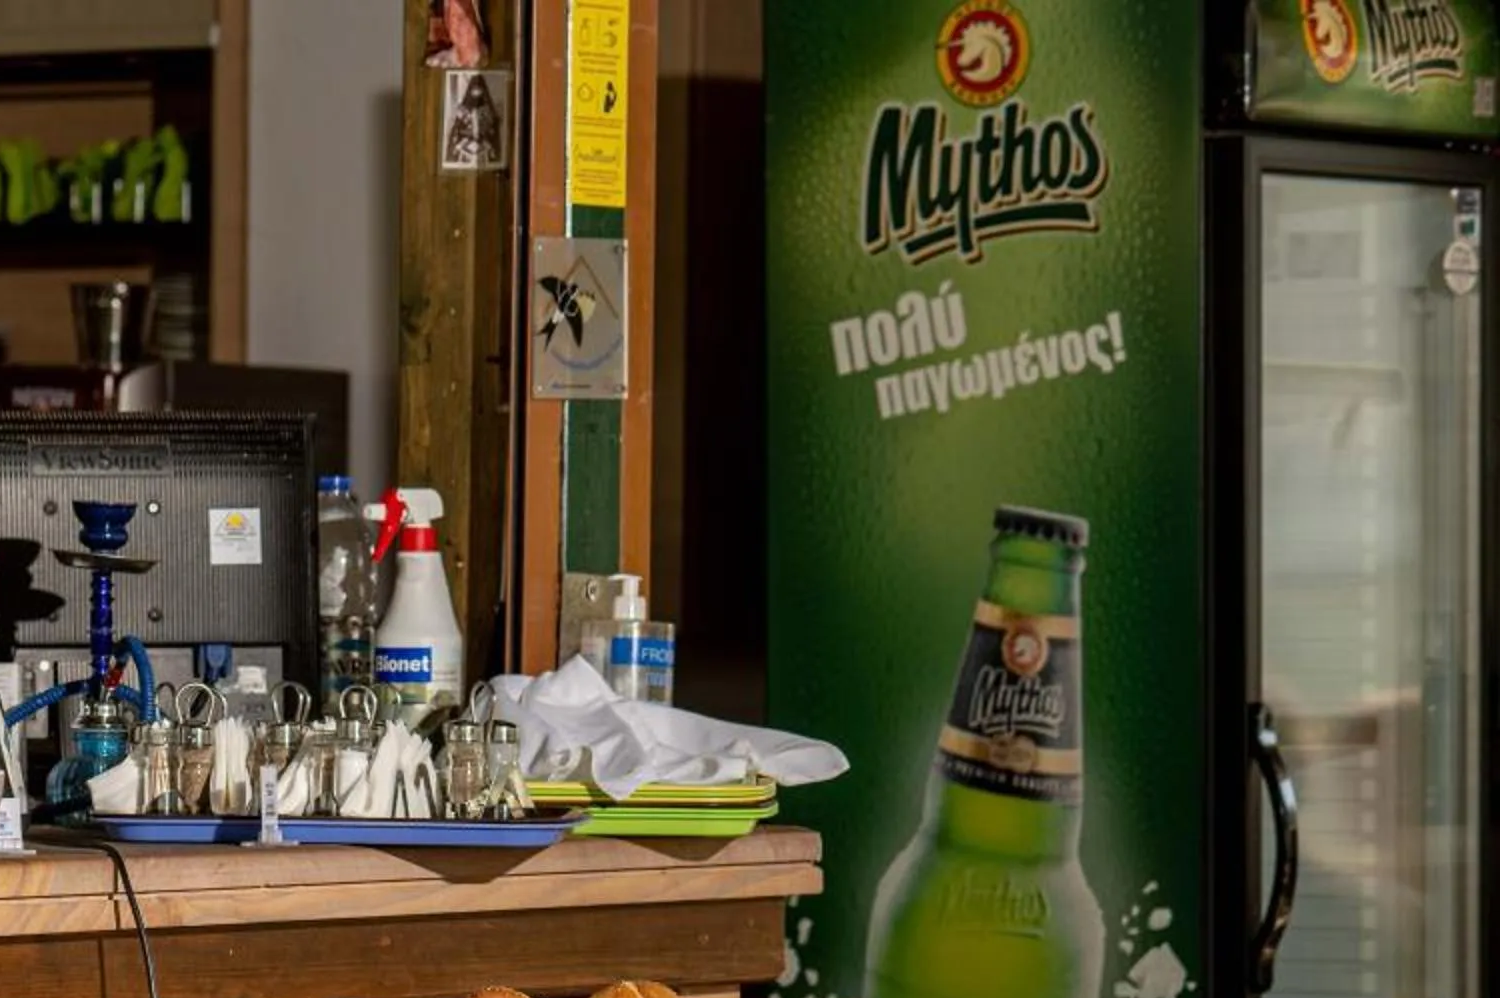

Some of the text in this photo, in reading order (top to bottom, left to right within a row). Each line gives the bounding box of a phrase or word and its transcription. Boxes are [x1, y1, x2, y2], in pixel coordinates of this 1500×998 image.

[1362, 0, 1462, 91] Mythos
[864, 100, 1104, 257] Mythos
[829, 279, 967, 376] πολύ
[875, 310, 1127, 420] παγωμένος!
[39, 449, 163, 470] ViewSonic
[375, 655, 430, 673] Bionet
[969, 664, 1066, 736] Mythos
